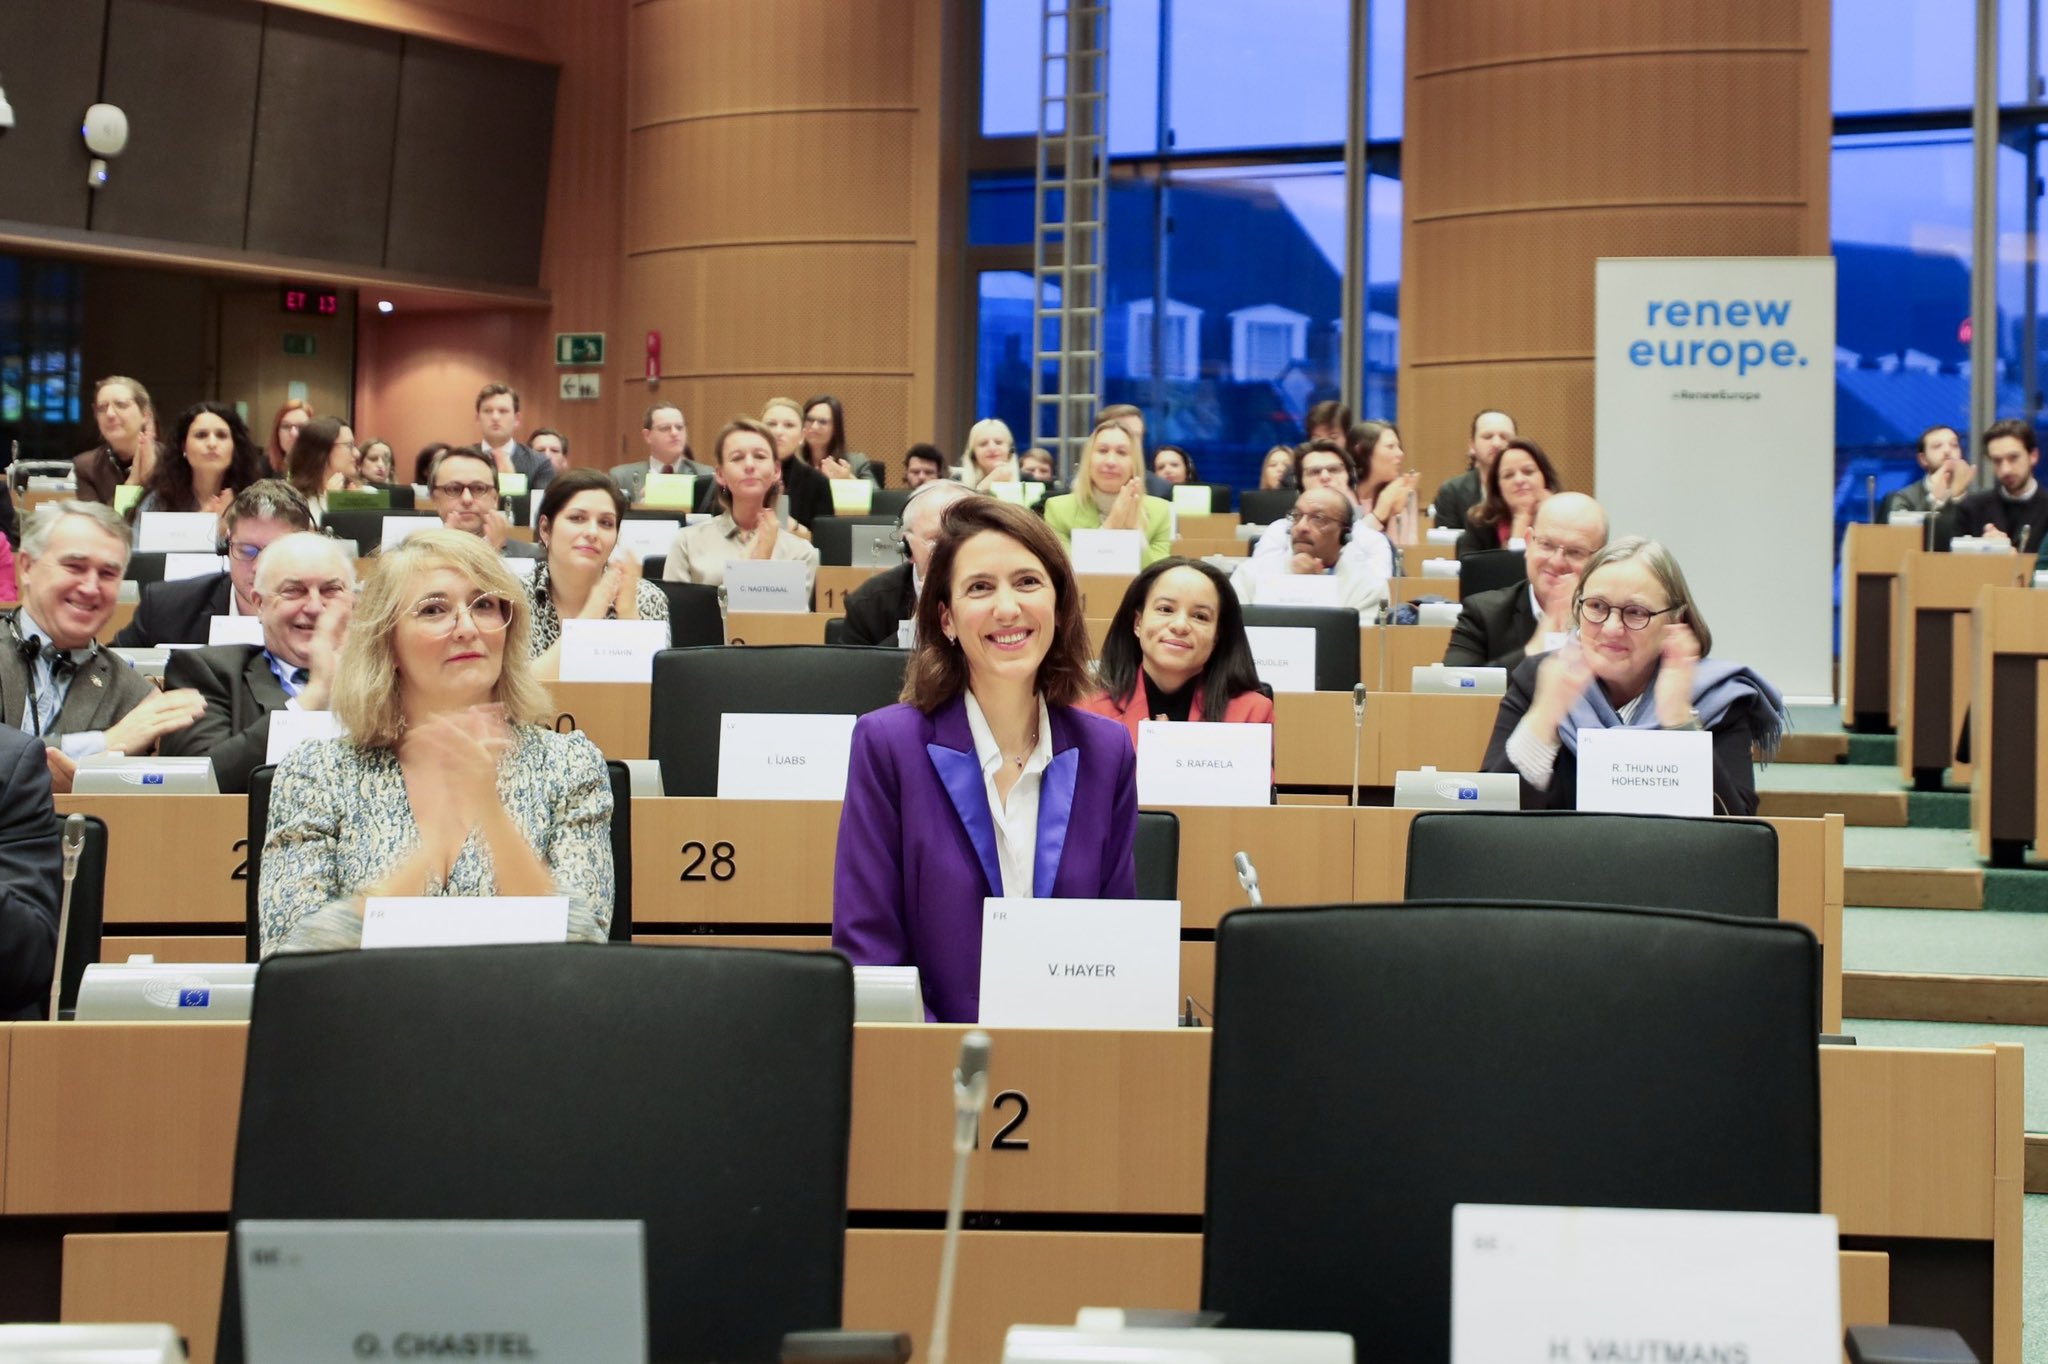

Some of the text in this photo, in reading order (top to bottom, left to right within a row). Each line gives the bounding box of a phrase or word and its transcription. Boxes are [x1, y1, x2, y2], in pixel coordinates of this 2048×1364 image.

[1647, 299, 1791, 327] renew
[1628, 339, 1808, 376] europe.
[748, 585, 788, 593] NAGTEGAAL
[1175, 759, 1234, 769] S. RAFAELA
[1625, 763, 1653, 773] THUN
[1656, 764, 1679, 774] UND
[1611, 777, 1679, 787] HOHENSTEIN
[680, 840, 736, 882] 28
[993, 912, 1007, 920] FR
[1048, 963, 1116, 977] V. HAYER
[392, 1332, 536, 1359] CHASTEL
[1583, 1338, 1750, 1364] VAUTMANS
